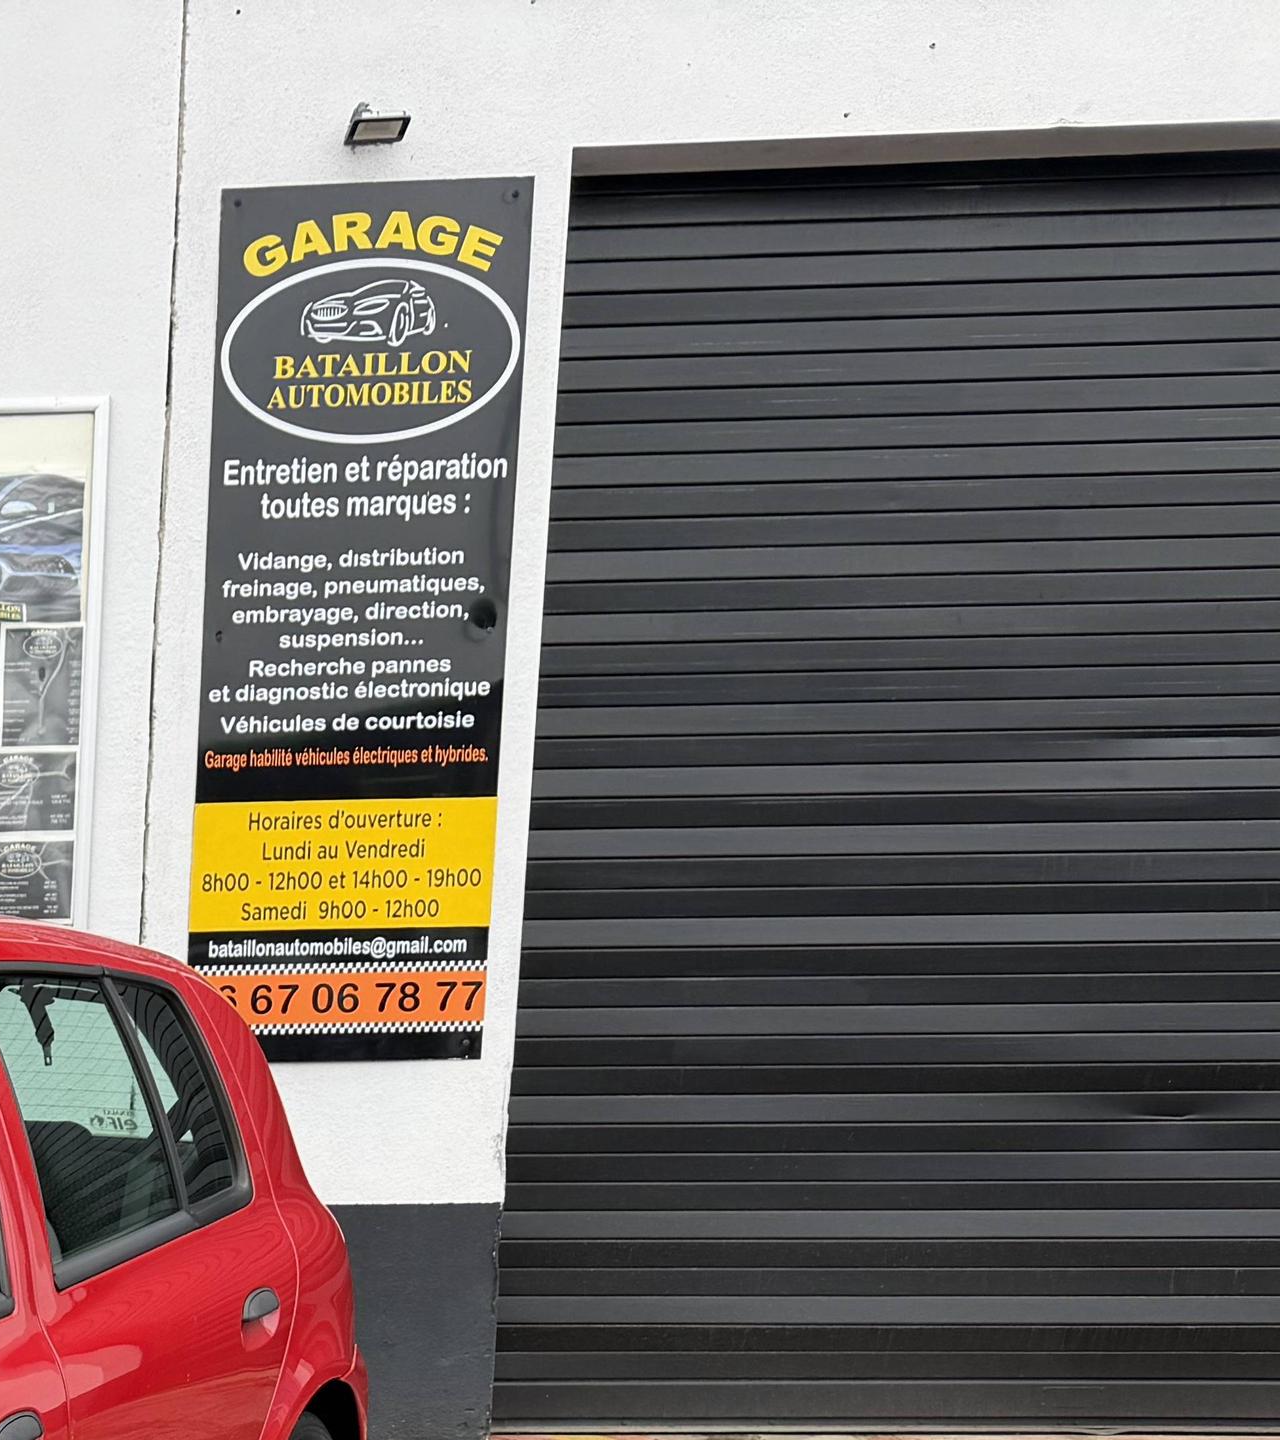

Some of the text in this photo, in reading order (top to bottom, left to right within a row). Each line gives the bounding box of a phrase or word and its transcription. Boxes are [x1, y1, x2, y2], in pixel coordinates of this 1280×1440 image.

[243, 211, 503, 277] GARAGE
[273, 349, 473, 379] BATAILLON
[267, 380, 473, 409] AUTOMOBILES
[223, 453, 508, 486] Entretien et réparation
[261, 494, 339, 519] toutes
[347, 491, 457, 521] marques
[238, 547, 465, 573] Vidange, distribution
[222, 574, 485, 600] freinage, pneumatiques,
[232, 602, 469, 626] embrayage, direction,
[279, 630, 424, 651] suspension...
[249, 657, 451, 678] Recherche pannes
[209, 678, 491, 705] et diagnostic électronique
[220, 711, 475, 734] Véhicules de courtoisie
[204, 744, 488, 772] Garage habilité véhicules électriques et hybrides.
[248, 812, 322, 831] Horaires
[328, 811, 431, 830] d'ouverture
[262, 838, 426, 861] Lundi au Vendredi
[202, 872, 250, 892] 8h00
[268, 871, 322, 891] 12h00
[328, 874, 346, 889] et
[352, 869, 407, 889] 14h00
[426, 868, 482, 887] 19h00
[241, 901, 307, 922] Samedi
[319, 900, 366, 920] 9h00
[385, 899, 439, 919] 12h00
[208, 935, 467, 962] bataillonautomobiles@gmail.com
[251, 984, 299, 1015] 67
[313, 983, 359, 1014] 06
[375, 981, 420, 1012] 78
[436, 980, 483, 1011] 77
